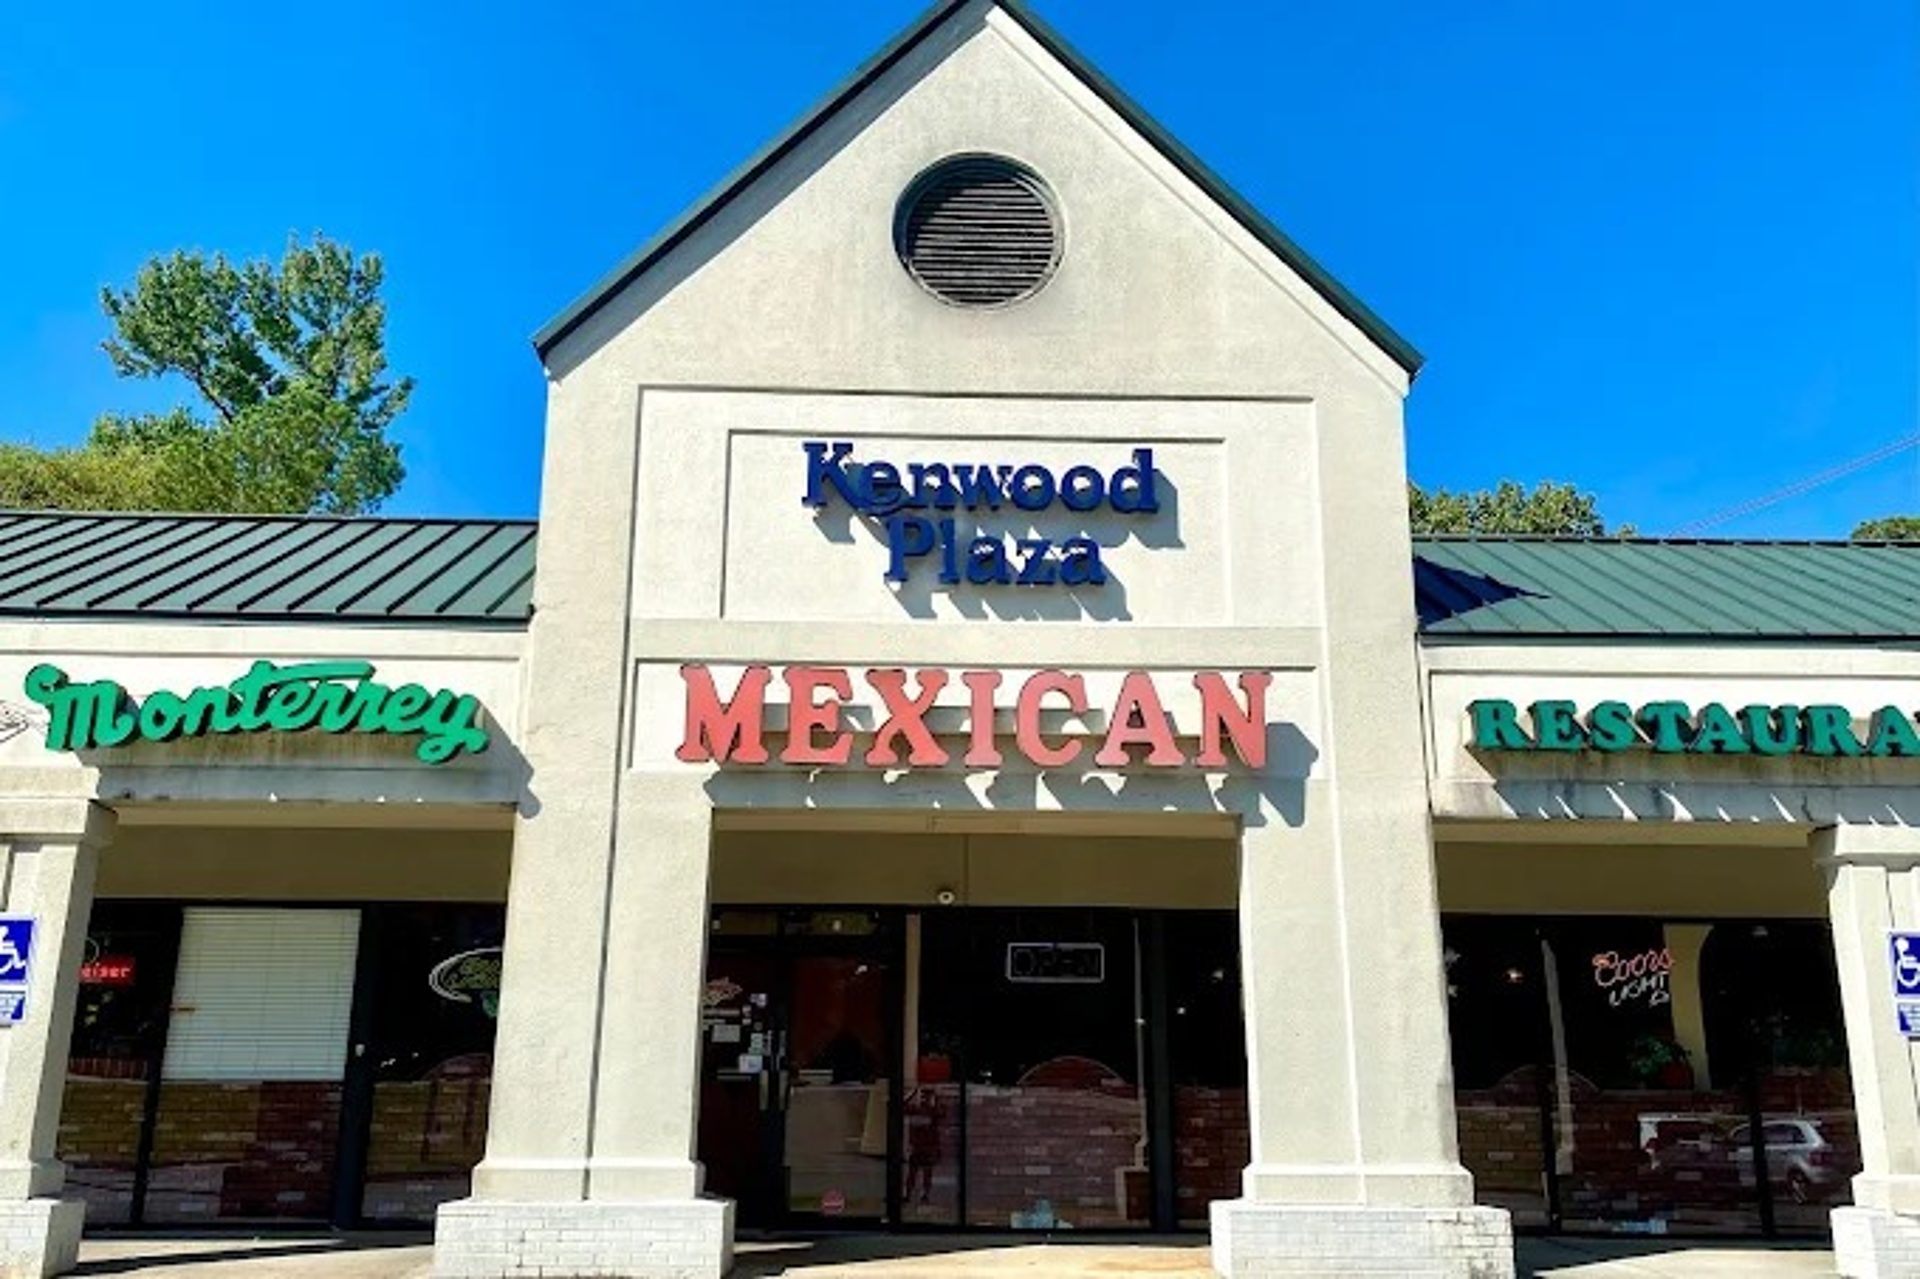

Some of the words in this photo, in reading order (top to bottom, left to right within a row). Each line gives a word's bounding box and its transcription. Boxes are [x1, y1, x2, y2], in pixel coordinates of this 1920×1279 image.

[802, 442, 1160, 516] Kenwood
[884, 516, 1106, 587] Plaza
[25, 660, 490, 763] Monterrey
[675, 664, 1274, 768] MEXICAN
[1467, 698, 1920, 757] RESTAURA
[1592, 948, 1673, 987] Coors
